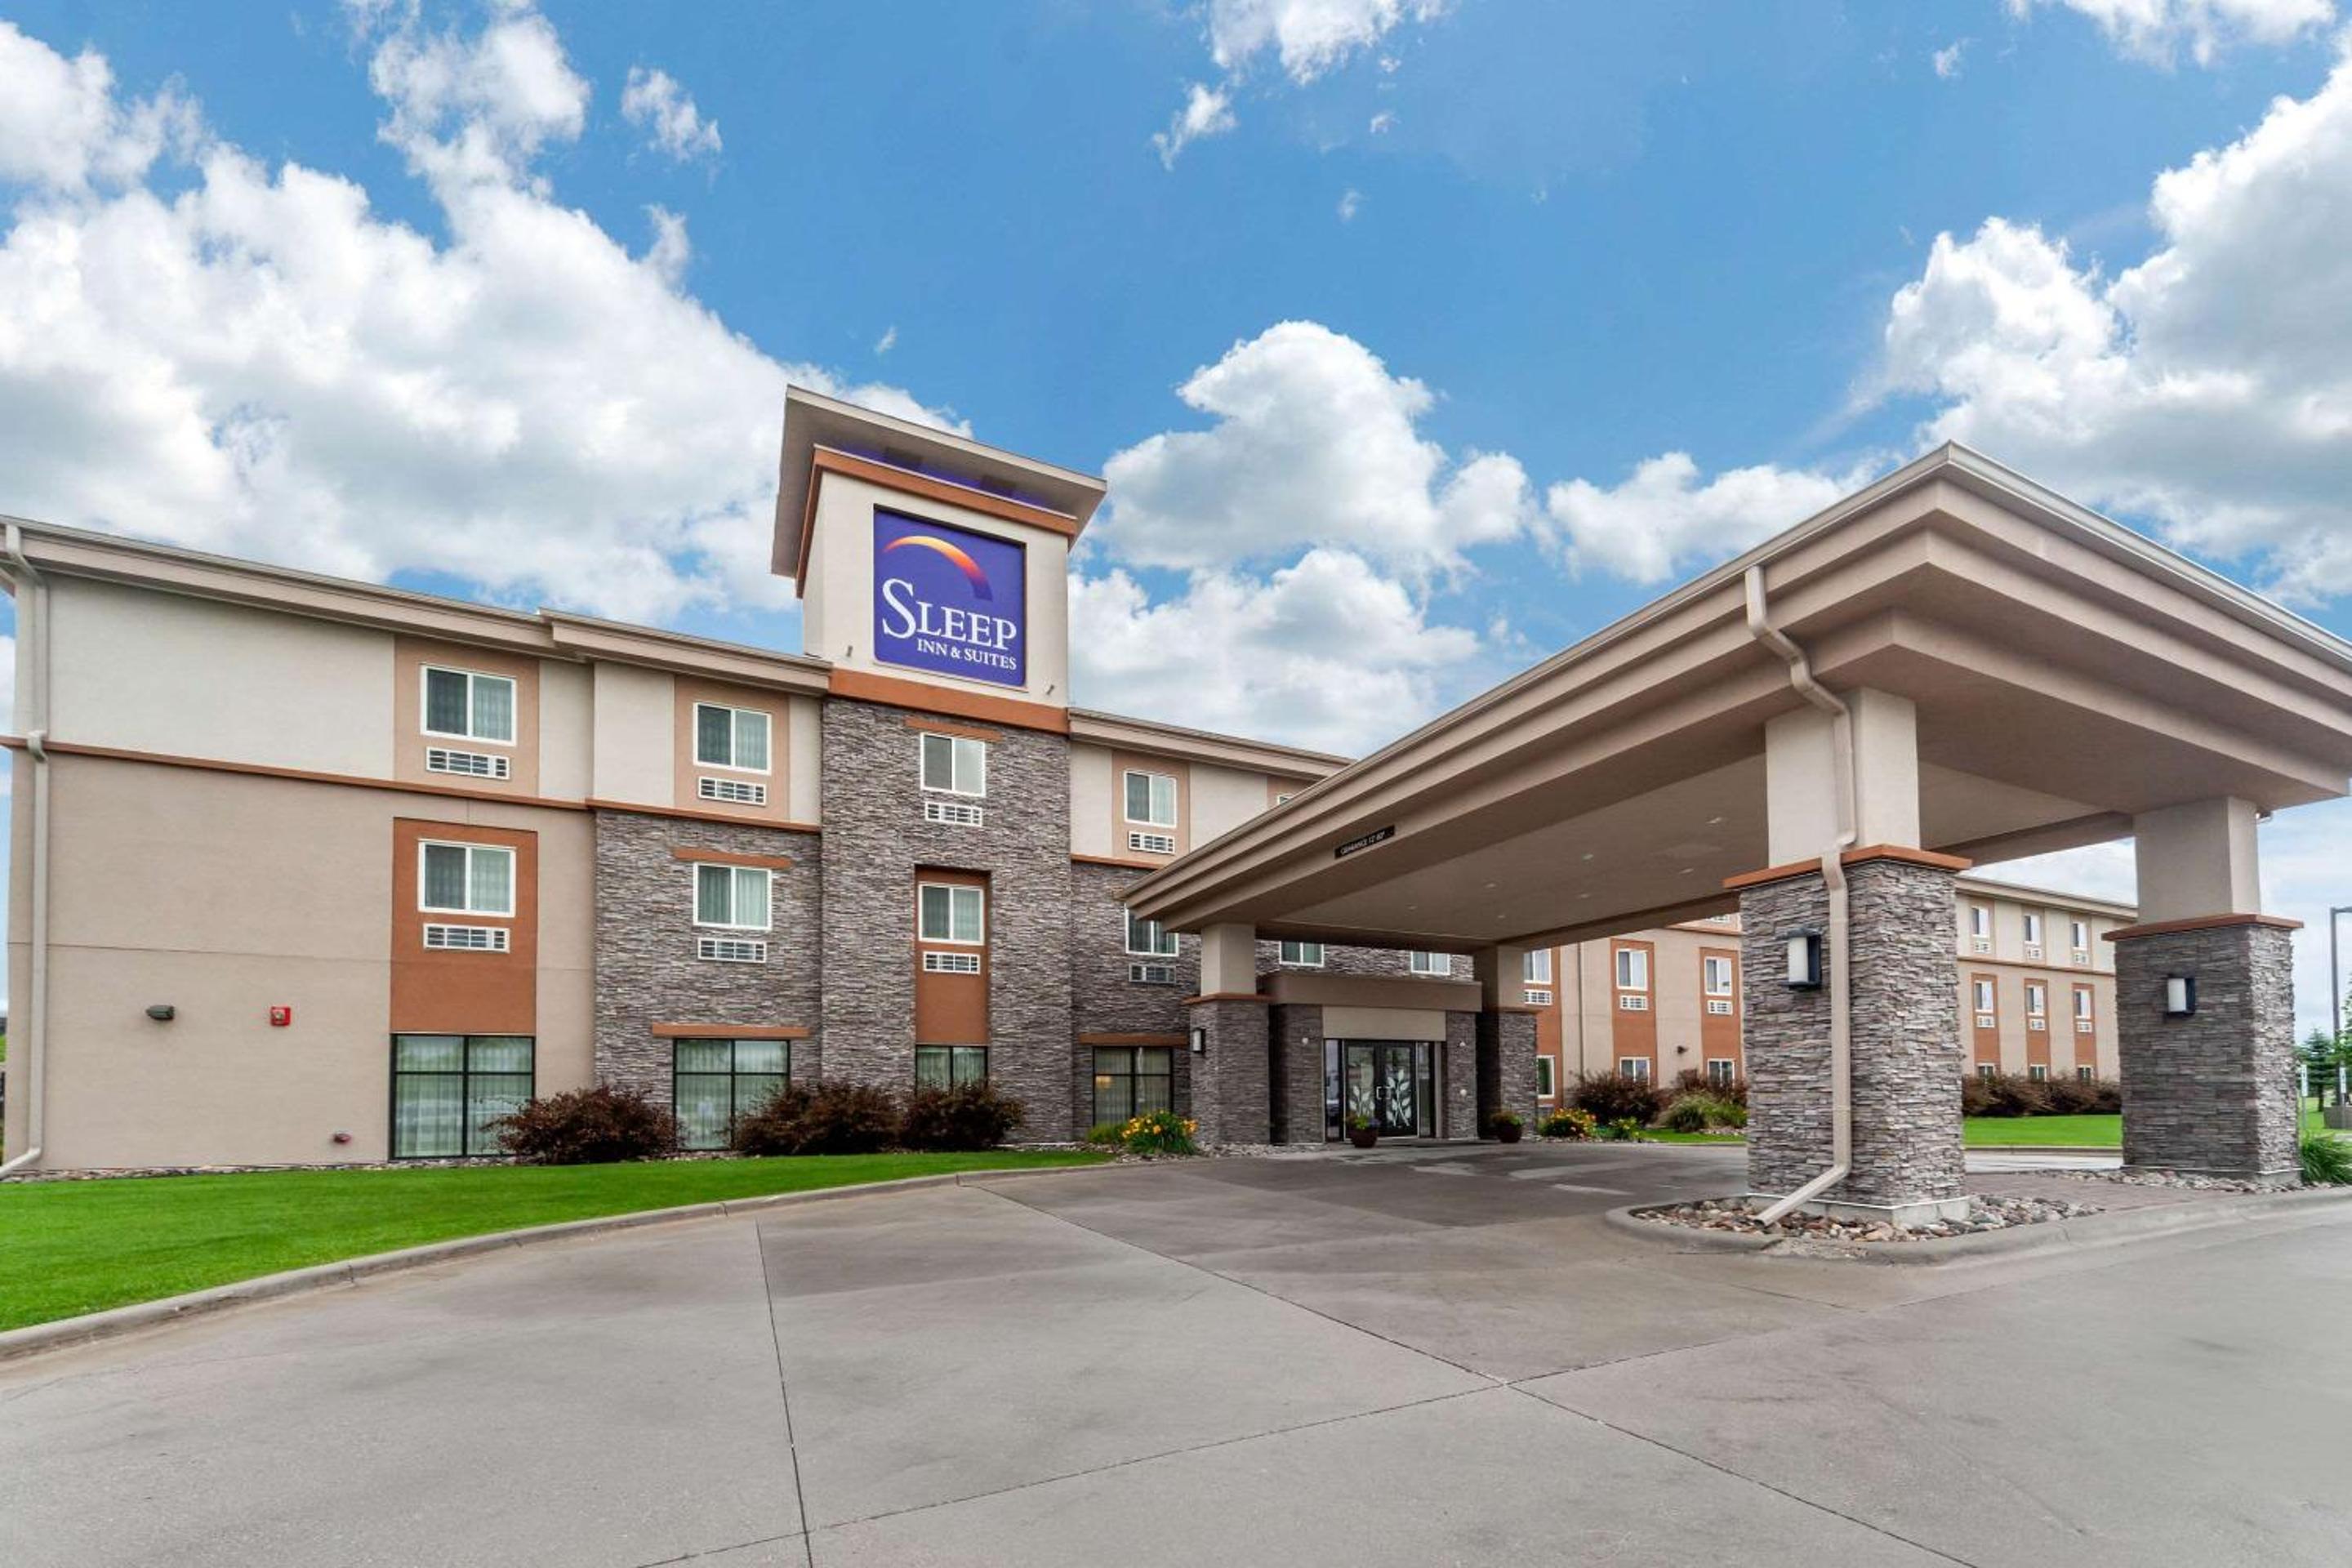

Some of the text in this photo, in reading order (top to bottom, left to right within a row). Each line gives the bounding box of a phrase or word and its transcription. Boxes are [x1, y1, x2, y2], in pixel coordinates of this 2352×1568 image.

[882, 577, 1017, 651] SLEEP
[917, 638, 1017, 670] INN & SUITES
